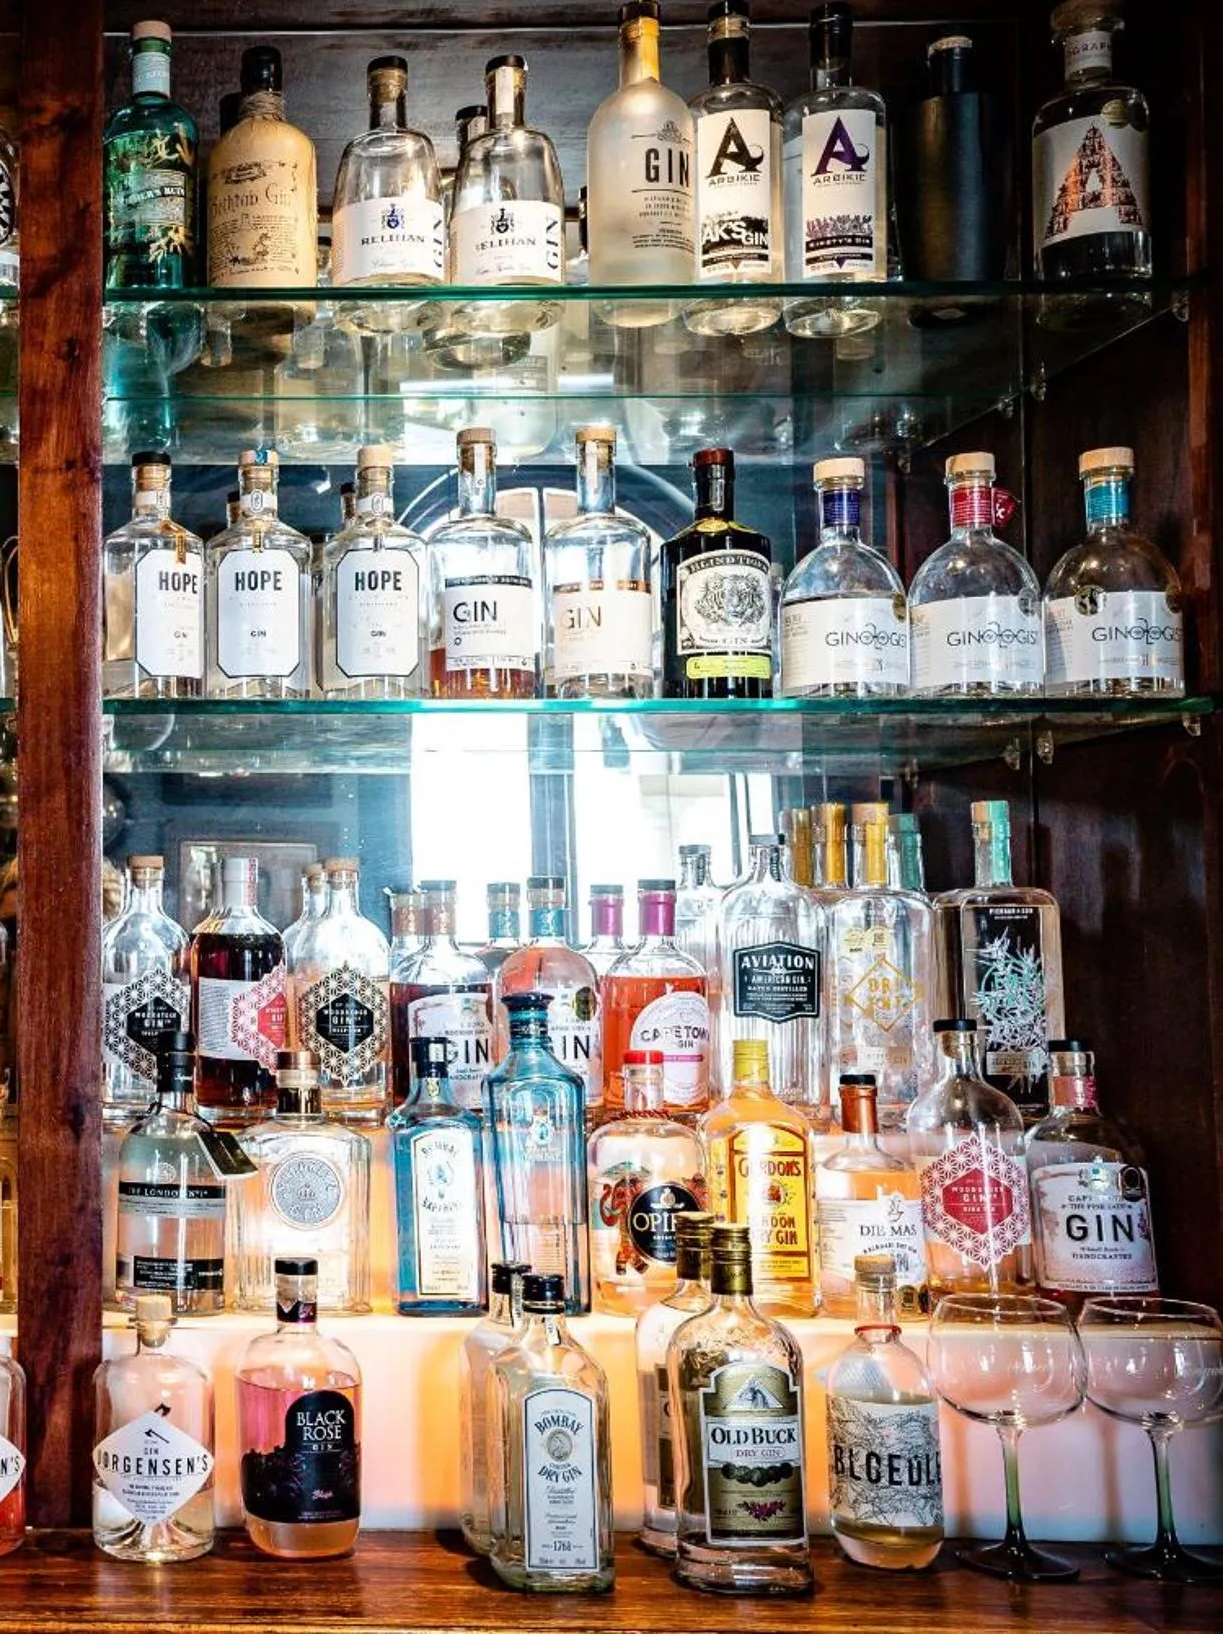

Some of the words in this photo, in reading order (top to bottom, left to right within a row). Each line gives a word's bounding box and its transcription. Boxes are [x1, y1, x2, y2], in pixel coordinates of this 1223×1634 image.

[644, 147, 691, 188] GIN
[361, 235, 426, 246] RELIHAN
[689, 554, 735, 574] BLIND
[158, 570, 198, 595] HOPE
[234, 570, 283, 592] HOPE
[354, 570, 403, 592] HOPE
[452, 601, 498, 623] GIN
[561, 606, 602, 630] GIN
[250, 630, 267, 638] GIN
[741, 953, 815, 971] AVIATION
[751, 974, 791, 984] AMERICAN
[143, 1019, 164, 1028] GIN
[639, 1026, 685, 1043] CAE
[562, 1034, 591, 1060] IN
[738, 1157, 802, 1178] GRDON'S
[632, 1212, 679, 1233] OPIH
[860, 1224, 886, 1237] DIE
[890, 1223, 917, 1237] MAS
[1065, 1214, 1135, 1242] GIN
[776, 1229, 798, 1246] GIN
[296, 1410, 346, 1427] BLACK
[534, 1415, 584, 1436] BOMBAY
[302, 1425, 342, 1441] ROSE
[710, 1426, 748, 1446] OLD
[751, 1426, 797, 1446] BUCK
[143, 1447, 159, 1455] GIN
[312, 1443, 333, 1451] GIN
[735, 1449, 758, 1458] DRY
[760, 1448, 781, 1458] GIN
[97, 1451, 209, 1476] JORGENSEN'S
[537, 1466, 560, 1484] DRY
[561, 1466, 583, 1484] GIN
